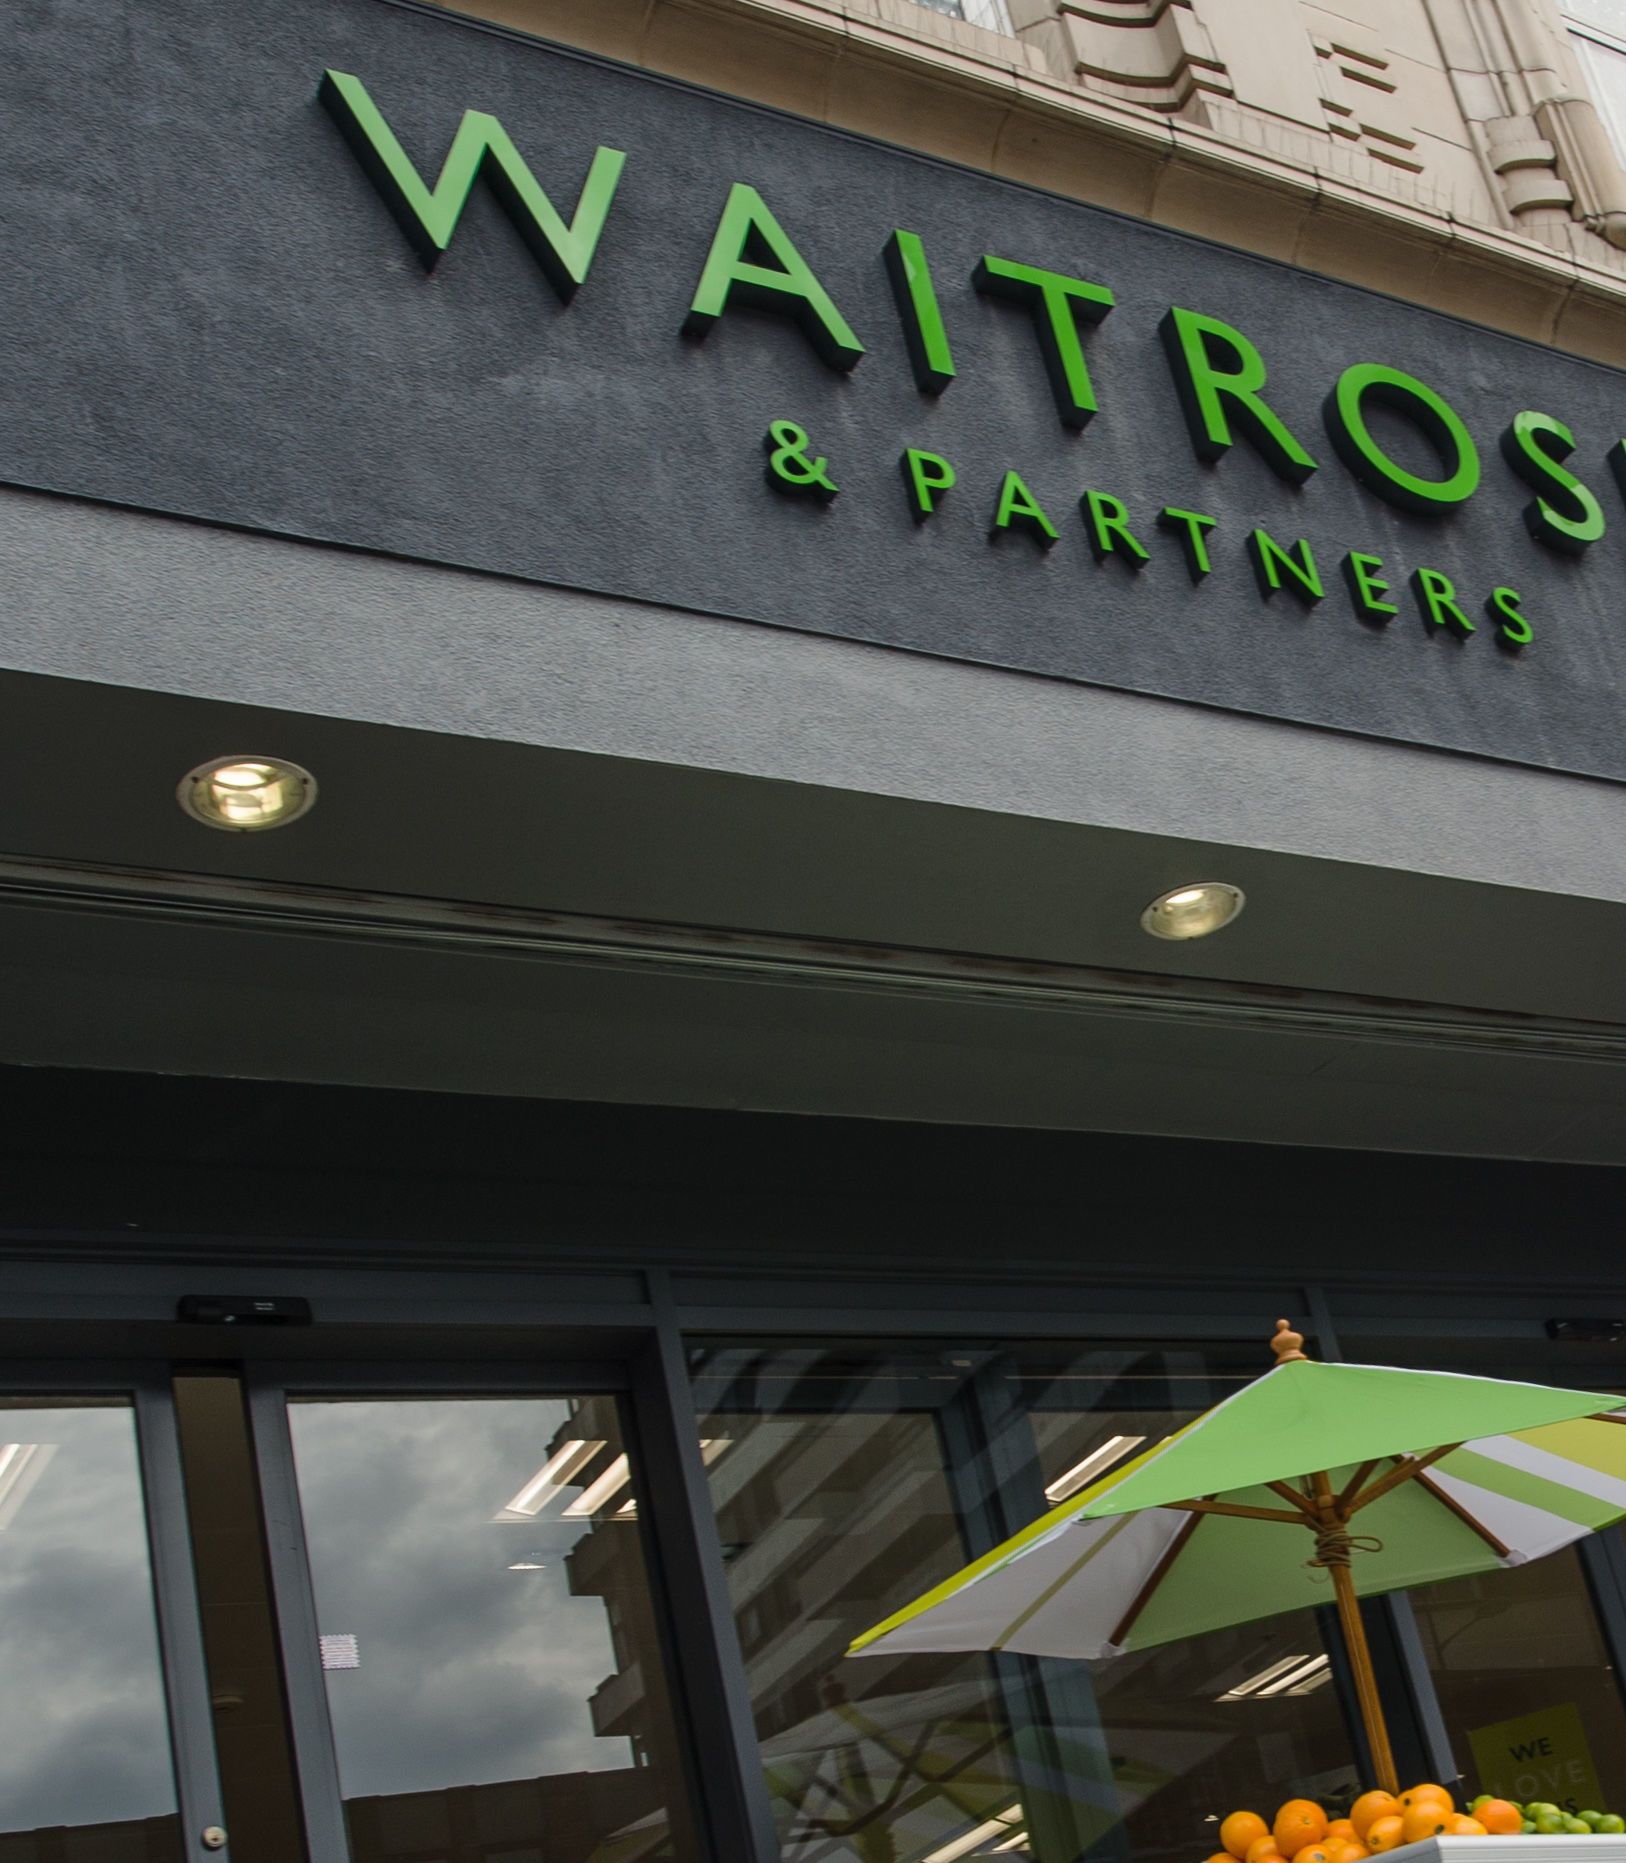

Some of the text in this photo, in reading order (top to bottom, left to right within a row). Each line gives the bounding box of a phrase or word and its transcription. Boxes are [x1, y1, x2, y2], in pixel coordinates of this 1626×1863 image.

[766, 419, 1534, 651] & PARTNERS
[1508, 1737, 1553, 1761] WE
